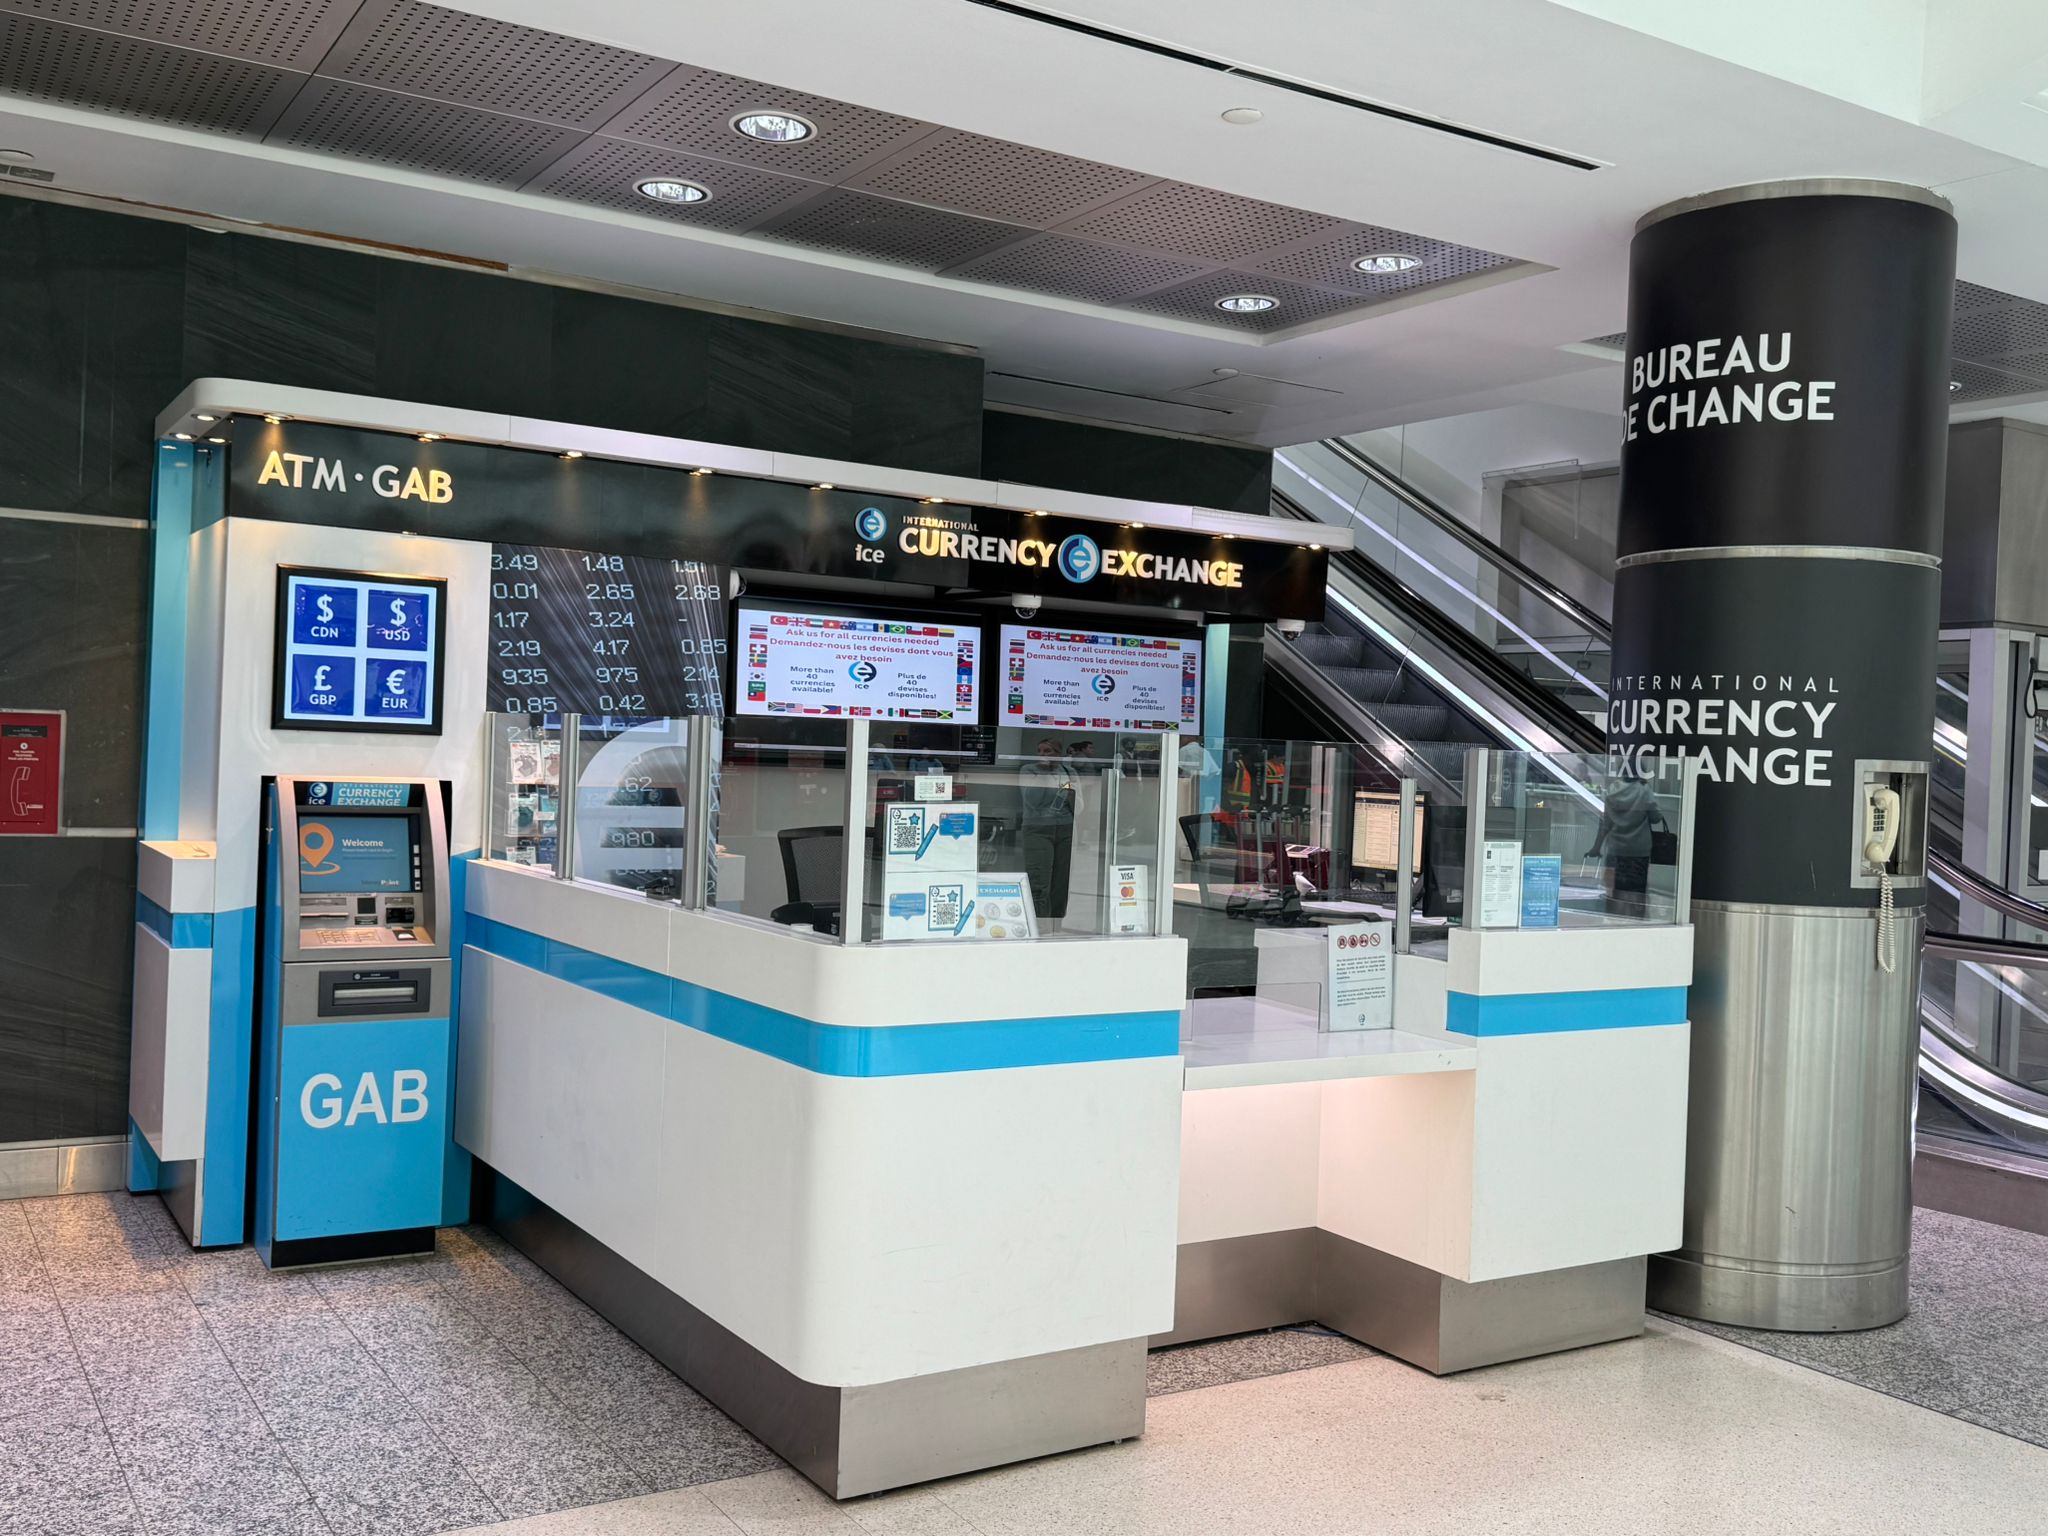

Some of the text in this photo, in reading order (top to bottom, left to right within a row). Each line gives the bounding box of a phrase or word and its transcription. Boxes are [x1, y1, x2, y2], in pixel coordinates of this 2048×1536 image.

[1632, 332, 1791, 394] BUREAU
[1647, 381, 1836, 434] CHANGE
[258, 450, 453, 504] ATM GAB
[902, 515, 980, 532] INTERNATIONAL
[855, 543, 885, 563] ice
[899, 527, 1244, 588] CURRENCY EXCHANGE
[492, 554, 539, 571] 3.49
[581, 555, 624, 572] 1.48
[493, 583, 538, 600] 0.01
[586, 584, 635, 600] 2.65
[674, 584, 720, 600] 2.68
[316, 594, 334, 623] $
[390, 598, 407, 626] $
[494, 611, 529, 628] 1.17
[589, 612, 635, 628] 3.24
[310, 626, 339, 638] CDN
[384, 629, 411, 641] USD
[786, 628, 804, 638] Ask
[820, 631, 834, 639] for
[837, 631, 849, 640] all
[851, 634, 902, 644] currencies
[904, 635, 940, 646] needed
[498, 640, 541, 657] 2.19
[593, 639, 630, 655] 4.17
[681, 638, 727, 654] 0.85
[770, 638, 851, 650] Demandez-nous
[853, 643, 868, 651] les
[870, 645, 905, 654] devises
[907, 647, 930, 655] dont
[1039, 642, 1055, 650] Ask
[1068, 644, 1081, 652] for
[1082, 645, 1093, 653] all
[1094, 646, 1137, 656] currencies
[1138, 650, 1168, 659] needed
[860, 654, 893, 663] besoin
[1026, 652, 1094, 663] Demandez-nous
[1095, 656, 1108, 664] les
[1109, 658, 1139, 667] devises
[1140, 660, 1160, 668] dont
[314, 665, 332, 691] £
[502, 668, 548, 685] 935
[596, 667, 638, 683] 975
[683, 666, 720, 682] 2.14
[897, 672, 914, 680] Plus
[1101, 667, 1129, 675] besoin
[386, 669, 407, 694] €
[790, 679, 836, 687] currencies
[897, 685, 928, 693] devises
[1612, 675, 1839, 693] INTERNATIONAL
[309, 694, 337, 705] GBP
[382, 697, 408, 709] EUR
[600, 695, 646, 711] 0.42
[685, 693, 723, 709] 3.18
[888, 691, 937, 700] disponibles!
[1043, 692, 1081, 700] currencies
[1044, 698, 1080, 706] available!
[506, 697, 557, 714] 0.85
[1124, 702, 1166, 711] disponibles!
[1610, 699, 1837, 738] CURRENCY
[1608, 744, 1833, 787] EXCHANGE
[308, 797, 326, 805] ice
[339, 788, 402, 798] CURRENCY
[337, 797, 401, 807] EXCHANGE
[342, 839, 384, 847] Welcome
[1121, 872, 1134, 880] VISA
[300, 1069, 429, 1129] GAB
